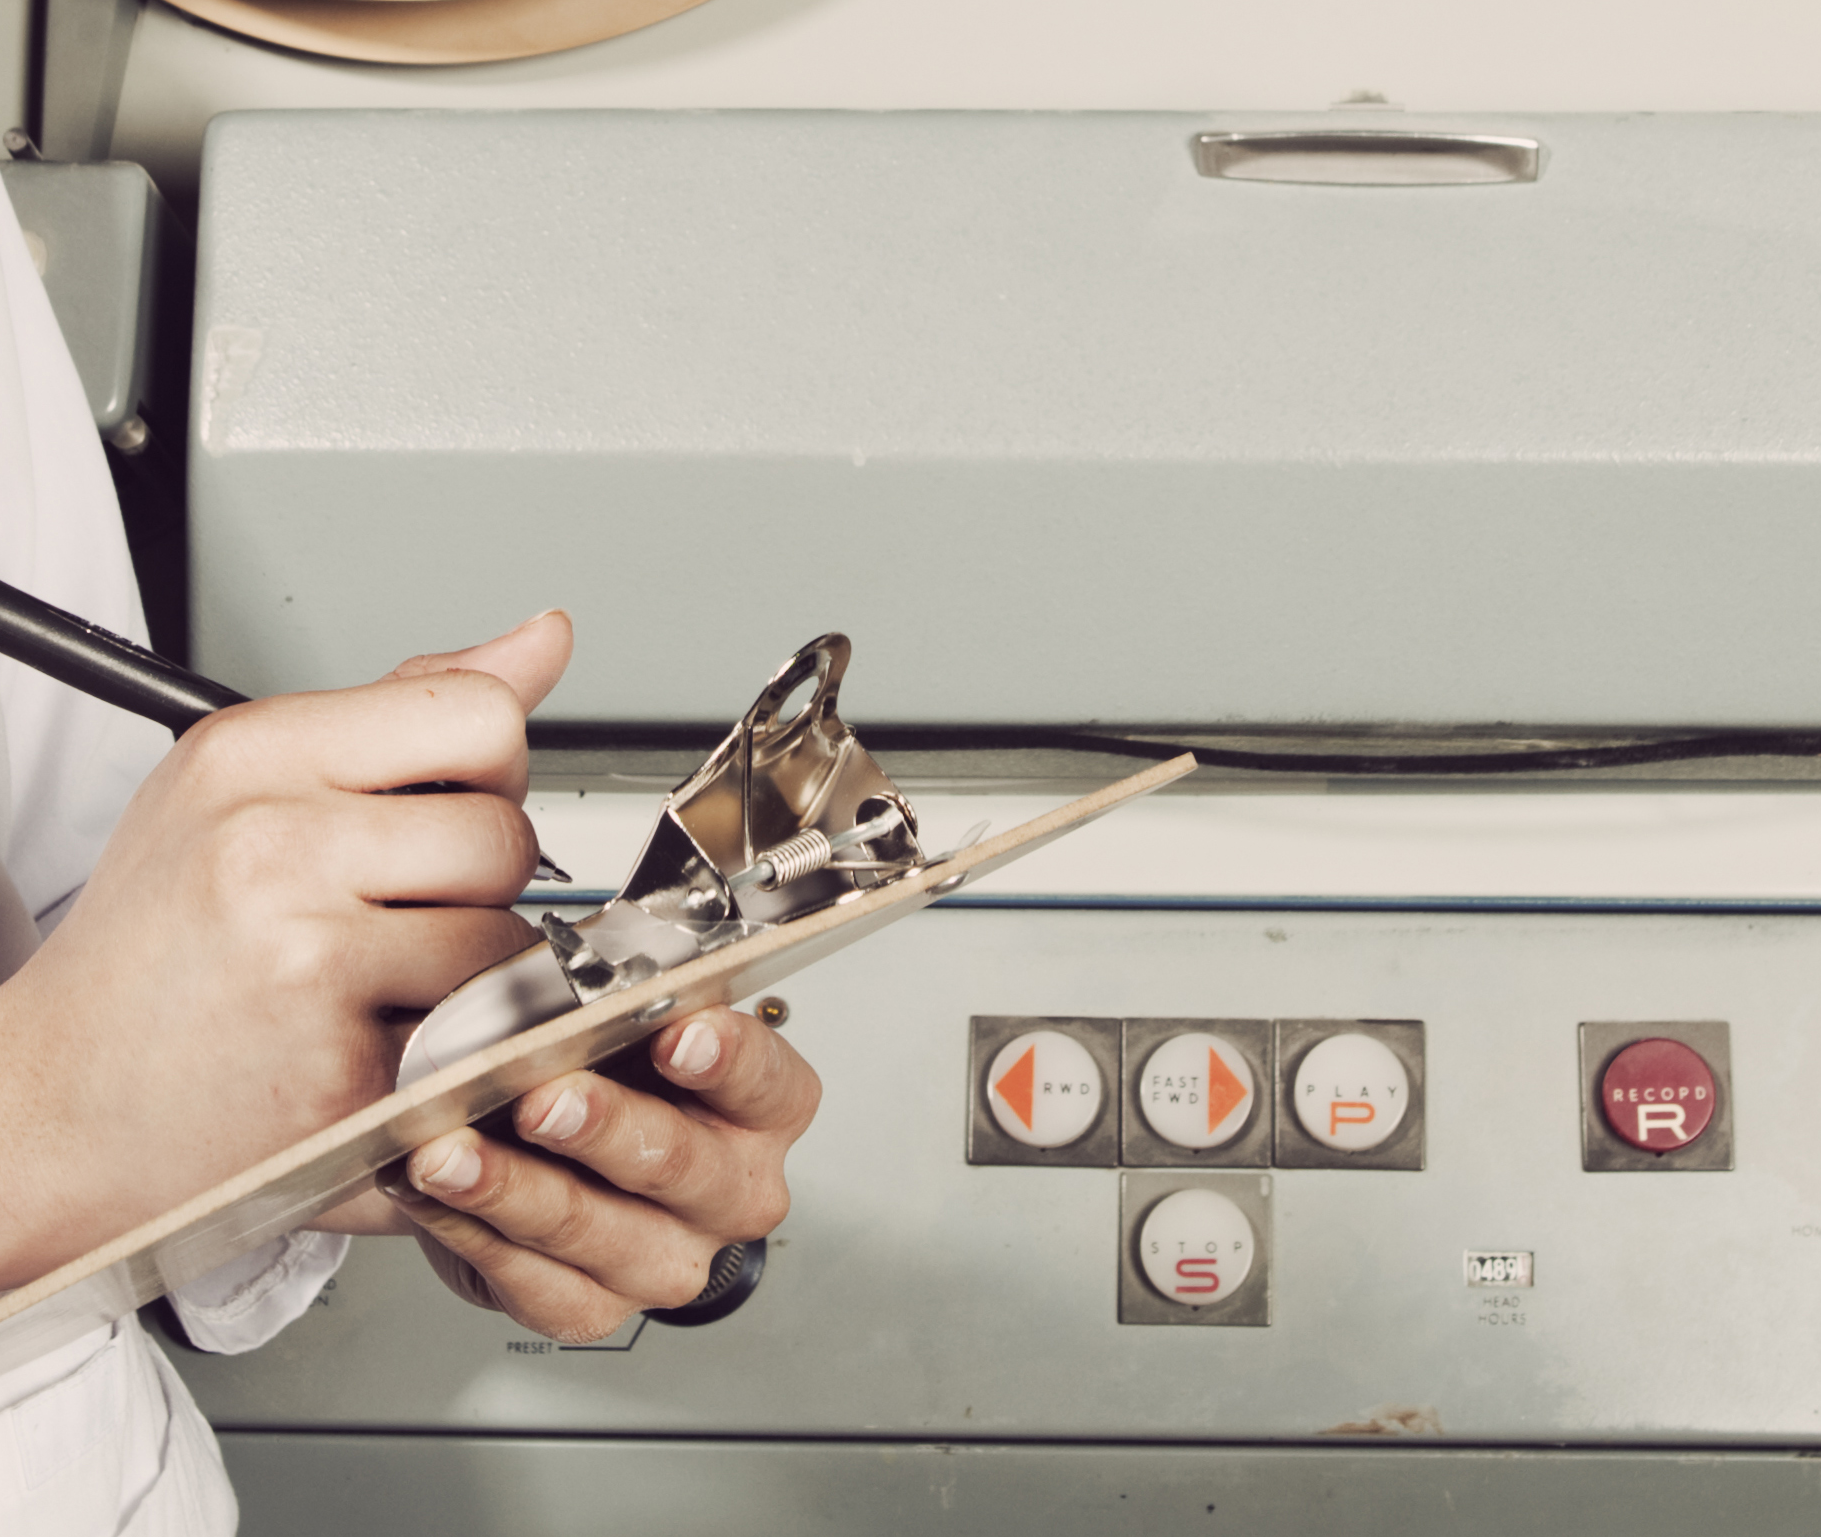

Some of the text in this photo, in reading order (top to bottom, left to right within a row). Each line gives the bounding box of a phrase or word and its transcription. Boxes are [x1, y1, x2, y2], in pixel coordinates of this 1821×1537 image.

[1043, 1081, 1091, 1095] RWD
[1151, 1075, 1200, 1089] FAST
[1151, 1091, 1200, 1105] FWD
[1306, 1084, 1398, 1098] PLAY
[1330, 1100, 1376, 1137] P
[1637, 1102, 1689, 1142] R
[1150, 1240, 1244, 1255] STOP
[1174, 1258, 1220, 1294] S
[1482, 1295, 1521, 1309] HEAD
[1478, 1312, 1527, 1326] HOURS
[506, 1341, 553, 1354] PRESET
